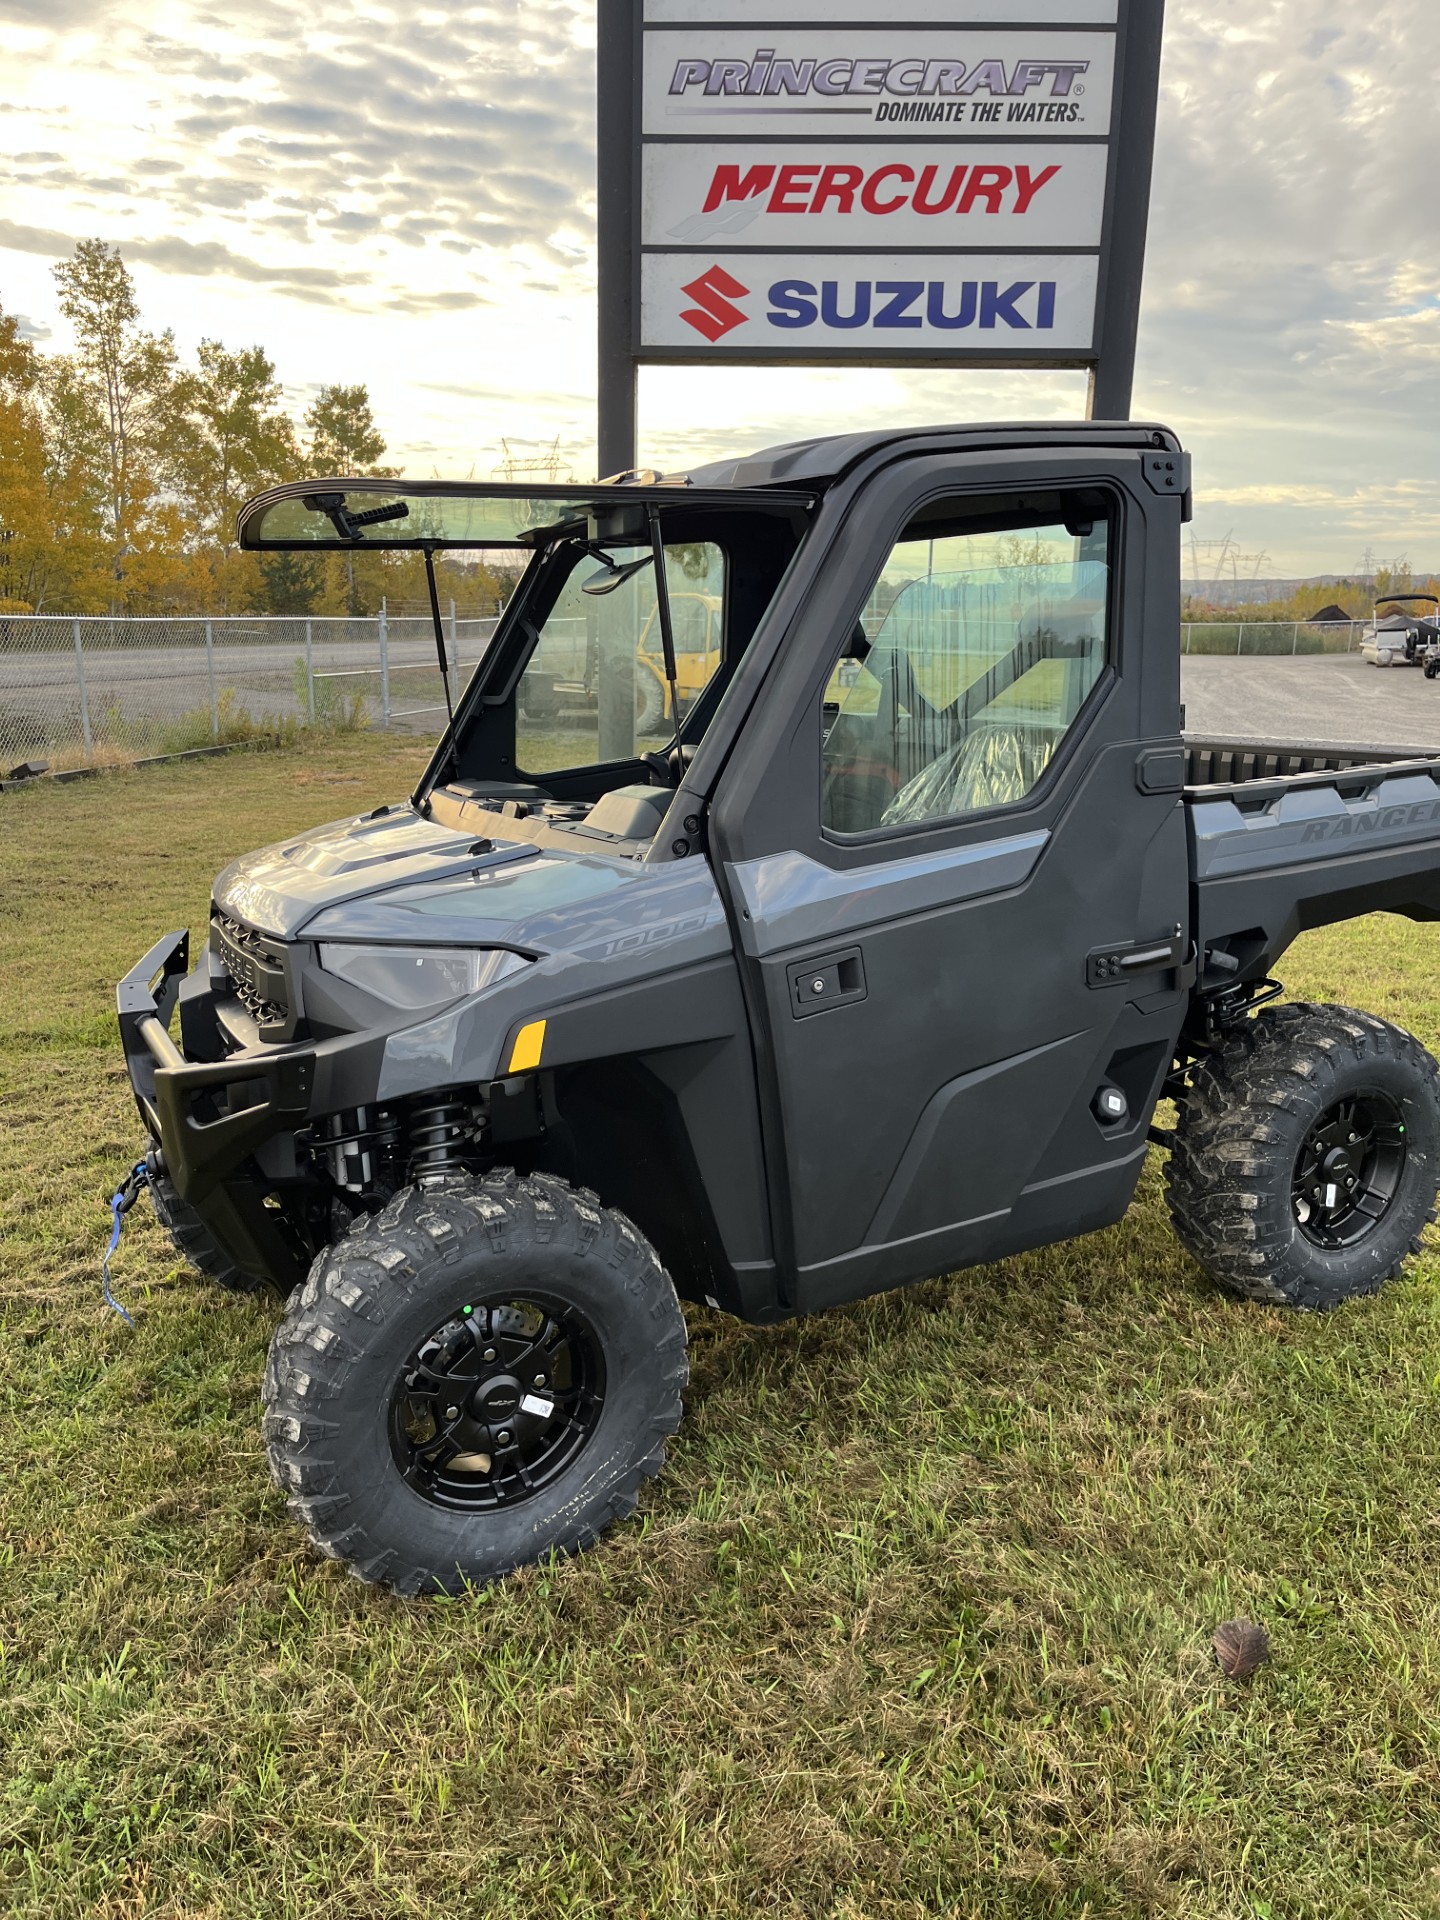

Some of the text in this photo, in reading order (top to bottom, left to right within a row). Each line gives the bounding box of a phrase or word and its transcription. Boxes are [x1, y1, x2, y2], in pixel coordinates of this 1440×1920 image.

[875, 102, 1080, 122] DOMINATE THE WATERS
[701, 164, 1062, 215] MERCURY
[766, 280, 1056, 329] SUZUKI
[605, 913, 708, 956] 1000
